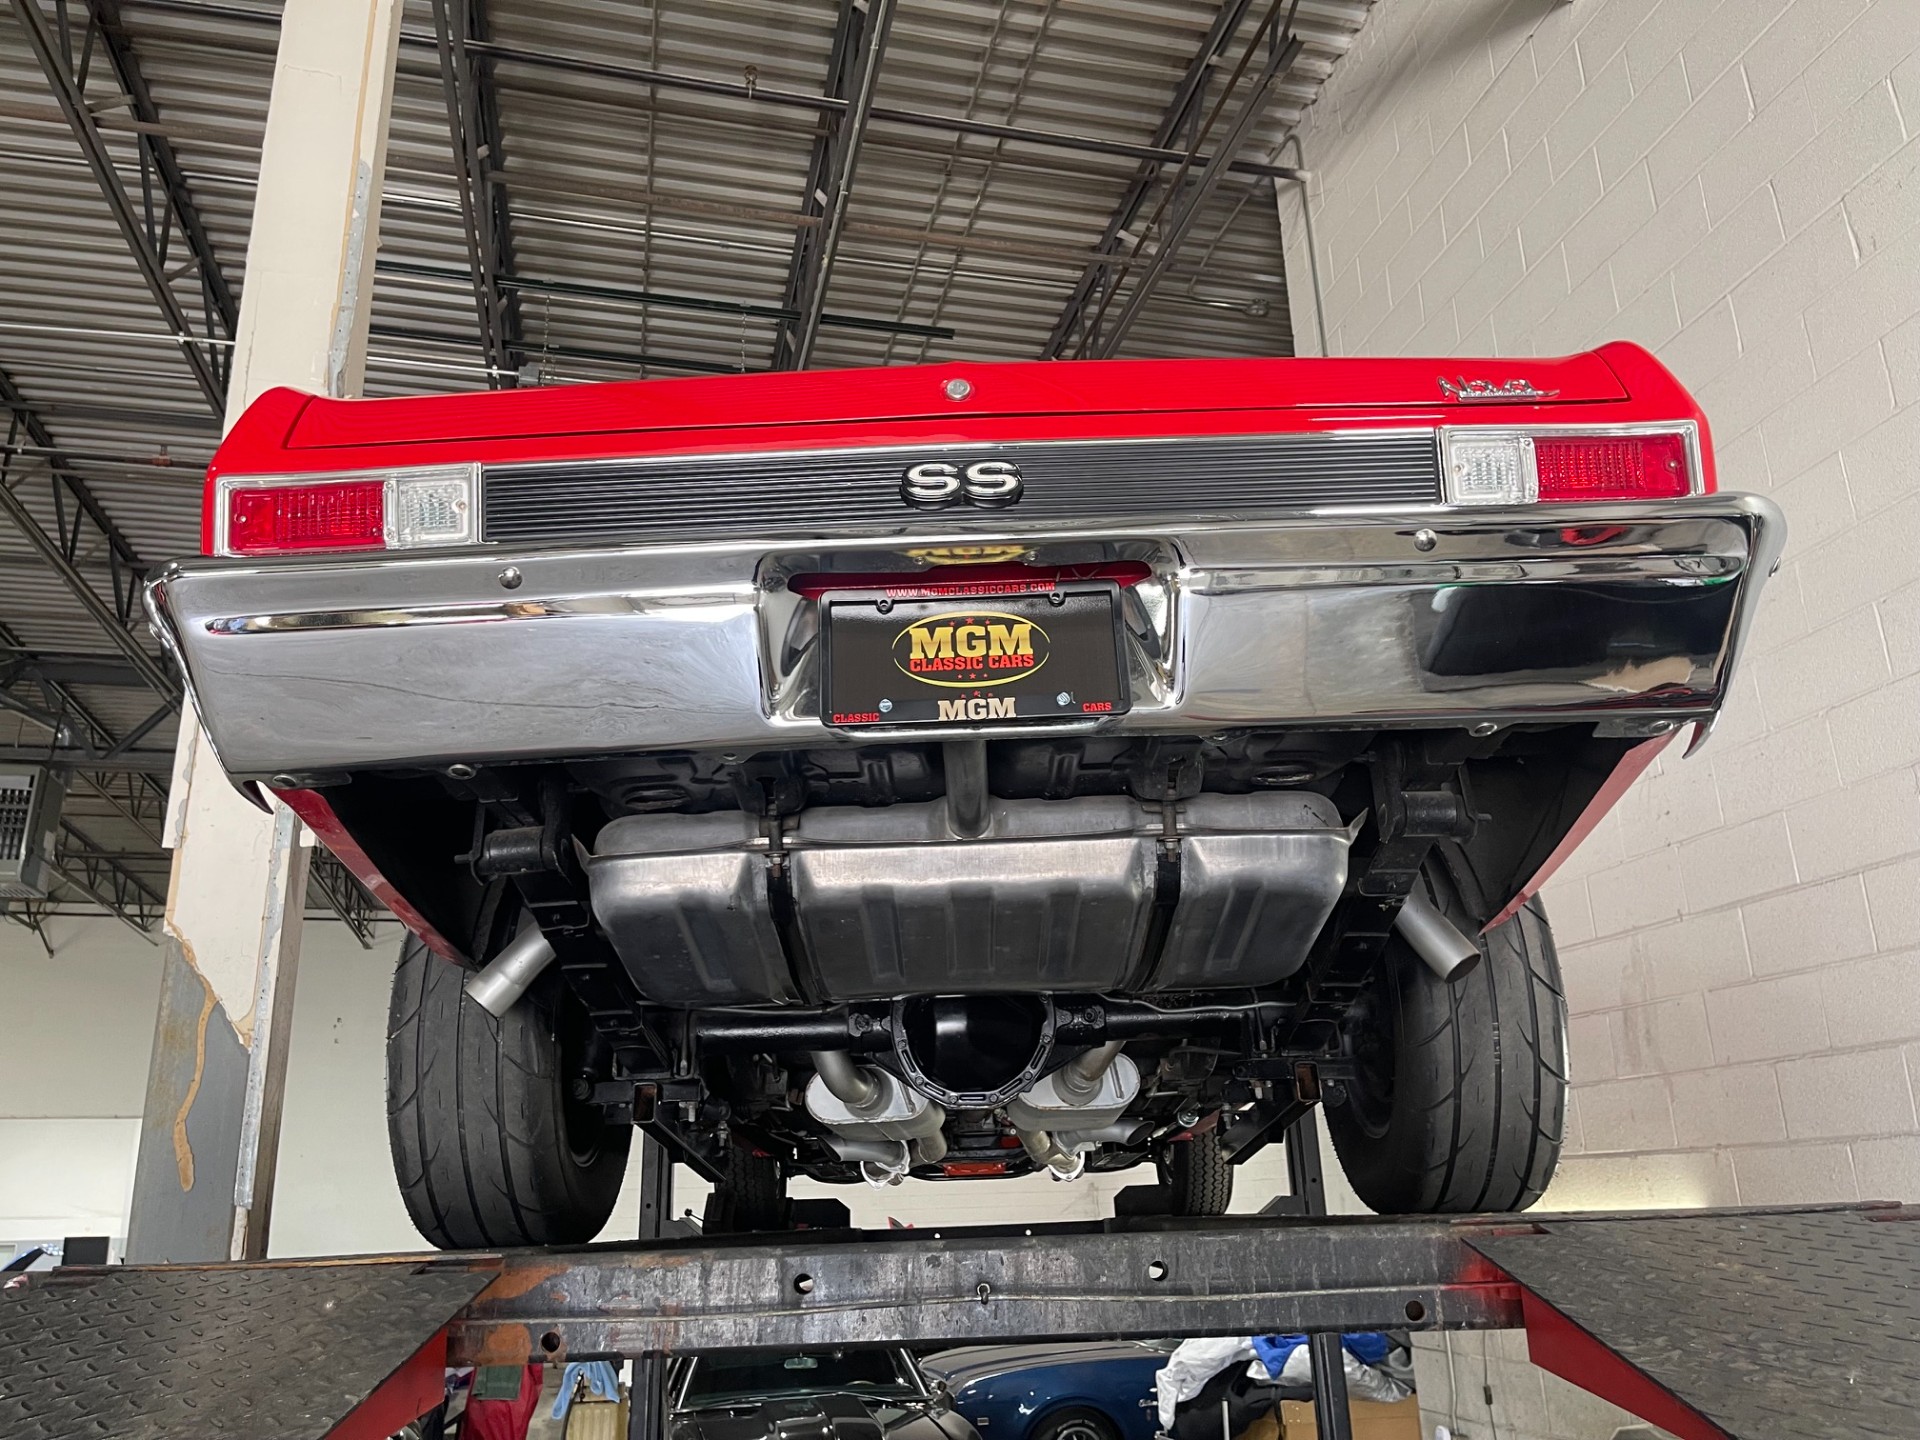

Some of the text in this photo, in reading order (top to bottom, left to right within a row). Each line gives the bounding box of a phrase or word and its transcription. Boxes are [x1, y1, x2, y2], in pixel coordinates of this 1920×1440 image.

[904, 461, 1021, 501] SS
[886, 583, 1056, 597] WWW.MGMCLASSICCARS.COM
[909, 624, 1033, 659] MGM
[909, 655, 1034, 672] CLASSIC CARS
[937, 697, 1016, 721] MGM
[1082, 702, 1112, 712] CARS
[832, 712, 880, 723] CLASSIC
